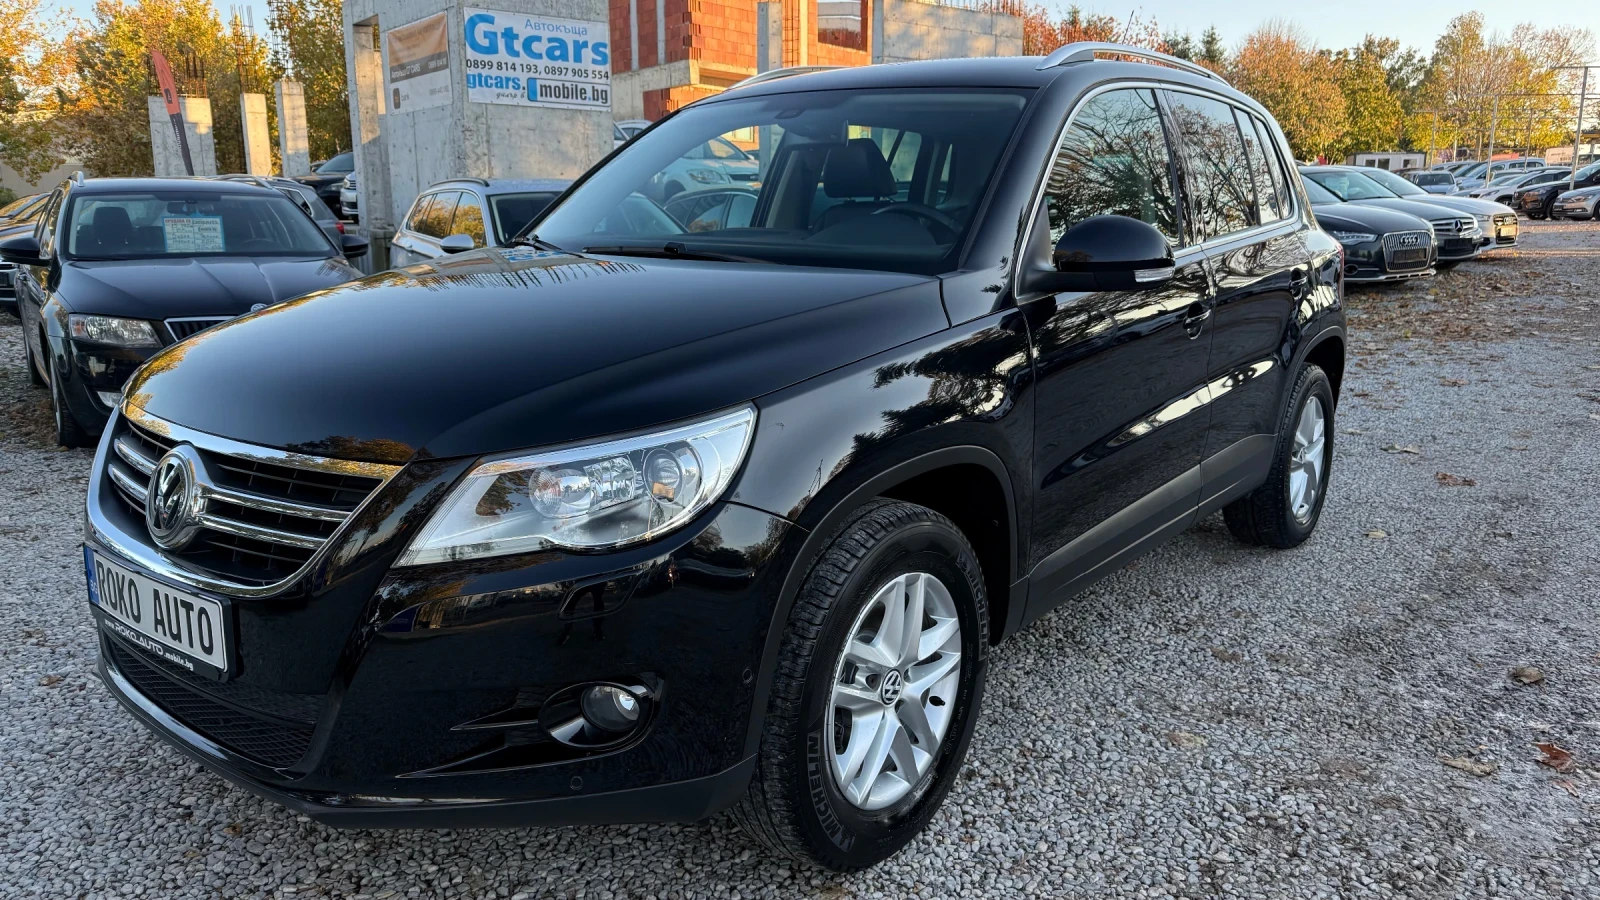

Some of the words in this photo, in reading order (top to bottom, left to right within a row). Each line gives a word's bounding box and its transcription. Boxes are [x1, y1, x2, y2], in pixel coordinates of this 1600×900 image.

[464, 13, 609, 66] Gtcars
[525, 19, 588, 37] Автокъща
[466, 59, 494, 70] 0899
[496, 62, 517, 72] 814
[519, 63, 542, 76] 193,
[544, 65, 569, 77] 0897
[571, 68, 589, 78] 905
[591, 69, 610, 80] 554
[540, 83, 609, 104] mobile.bg
[95, 559, 142, 624] ROKO
[153, 588, 214, 656] AUTO
[807, 735, 842, 839] MICHELIN
